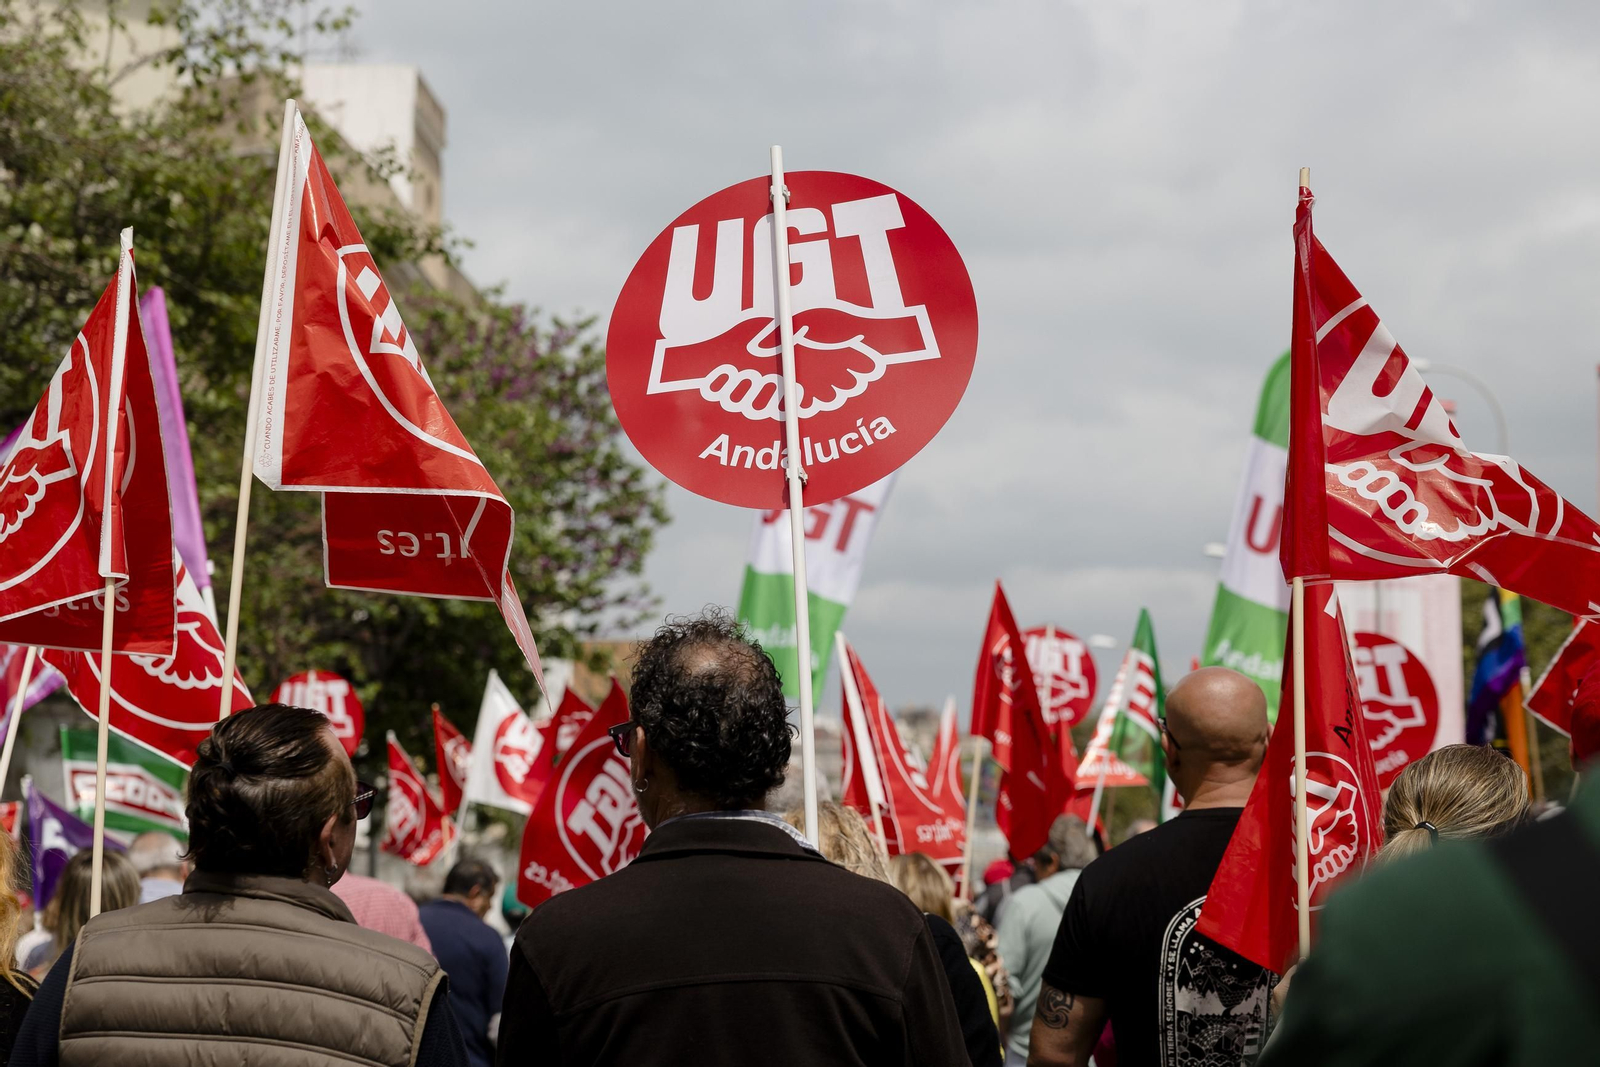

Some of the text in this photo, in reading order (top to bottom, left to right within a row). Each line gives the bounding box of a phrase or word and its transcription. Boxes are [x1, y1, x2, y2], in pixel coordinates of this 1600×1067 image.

[659, 192, 906, 340] UGT
[269, 375, 276, 385] DE
[266, 385, 274, 415] ACABES
[1171, 917, 1194, 949] LLAMA
[1167, 965, 1175, 973] Y
[1168, 951, 1176, 963] SE
[1167, 1024, 1175, 1055] TIERRA
